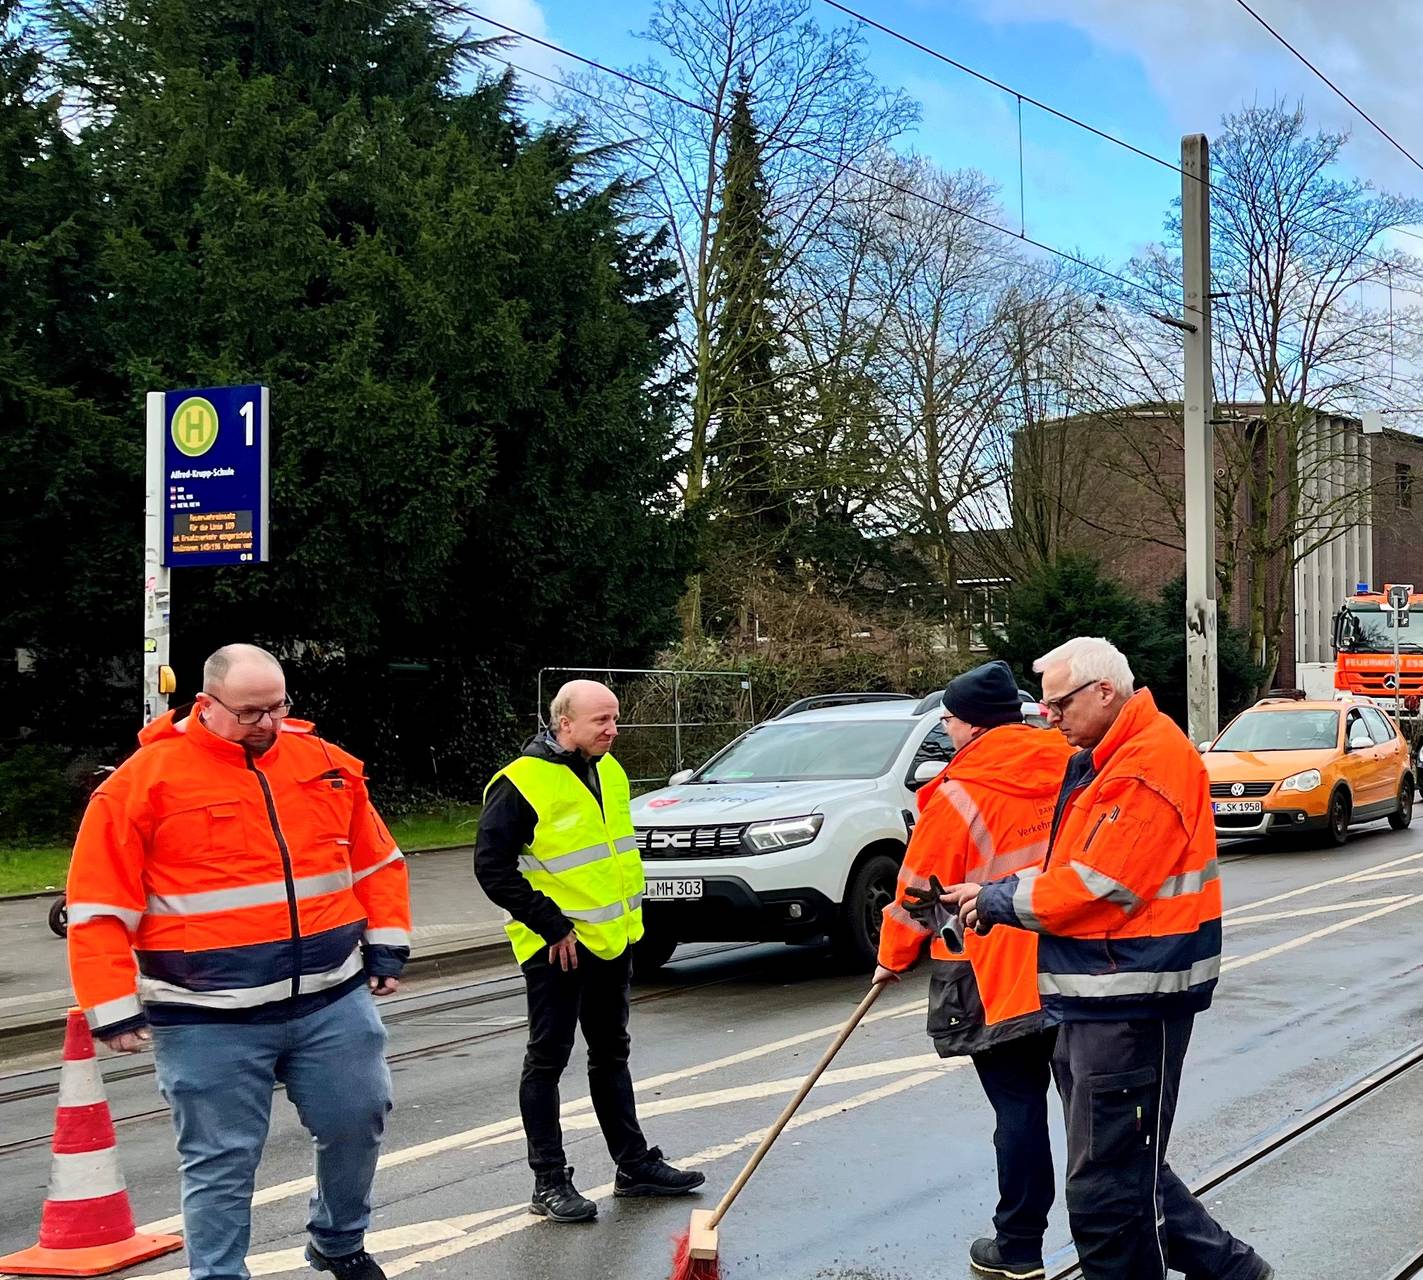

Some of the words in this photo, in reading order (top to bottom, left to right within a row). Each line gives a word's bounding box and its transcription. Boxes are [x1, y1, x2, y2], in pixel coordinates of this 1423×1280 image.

[185, 410, 204, 443] H
[239, 401, 253, 446] 1
[170, 467, 235, 478] Alfred-Krupp-Schule
[1216, 803, 1222, 812] E
[1226, 803, 1238, 812] SK
[1239, 802, 1260, 812] 1958
[1017, 821, 1052, 836] Verkehr
[656, 881, 674, 896] MH
[676, 881, 702, 896] 303
